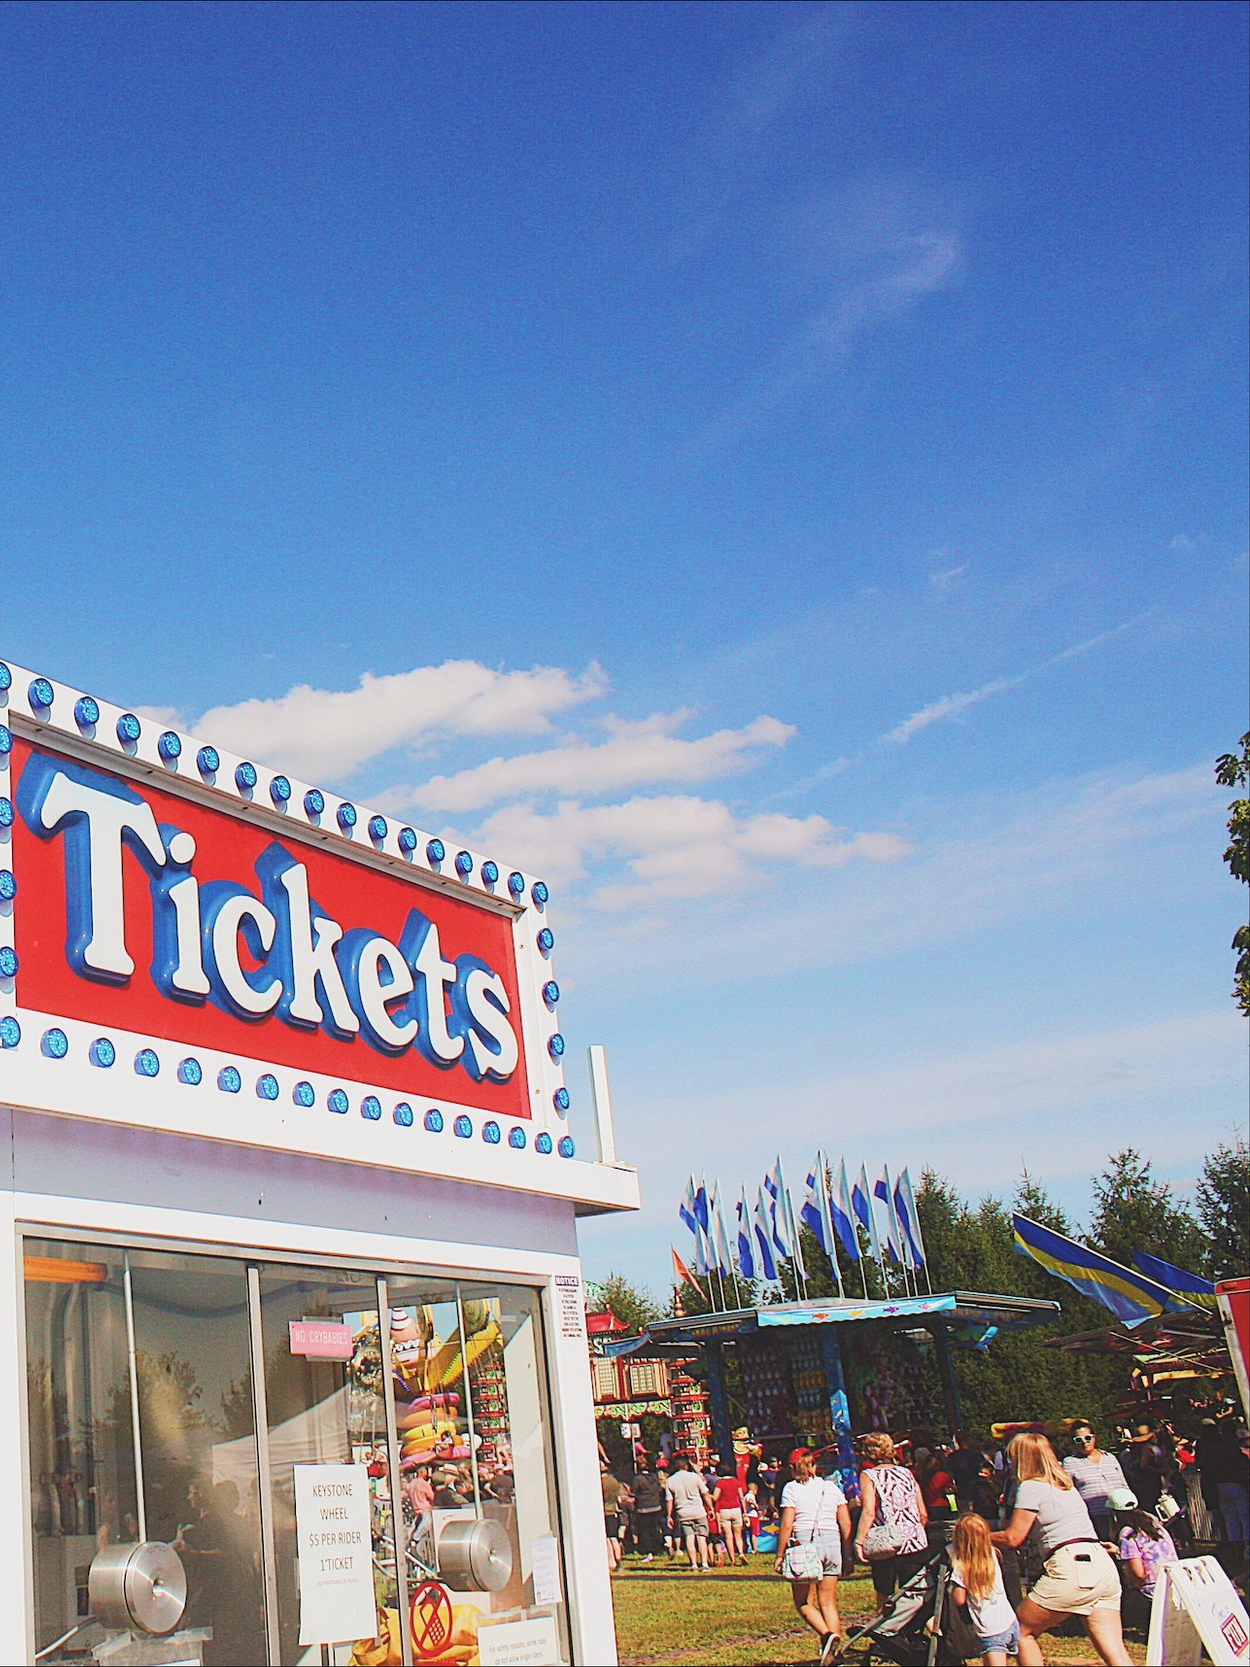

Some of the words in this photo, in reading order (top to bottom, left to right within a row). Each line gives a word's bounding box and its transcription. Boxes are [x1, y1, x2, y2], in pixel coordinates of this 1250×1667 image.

[32, 766, 519, 1078] Tickets
[295, 1331, 306, 1343] NO
[310, 1331, 348, 1345] CRYBABIES
[312, 1484, 353, 1497] KEYSTONE
[320, 1508, 348, 1520] WHEEL
[309, 1534, 319, 1547] $5
[321, 1532, 337, 1546] PER
[338, 1531, 361, 1544] RIDER
